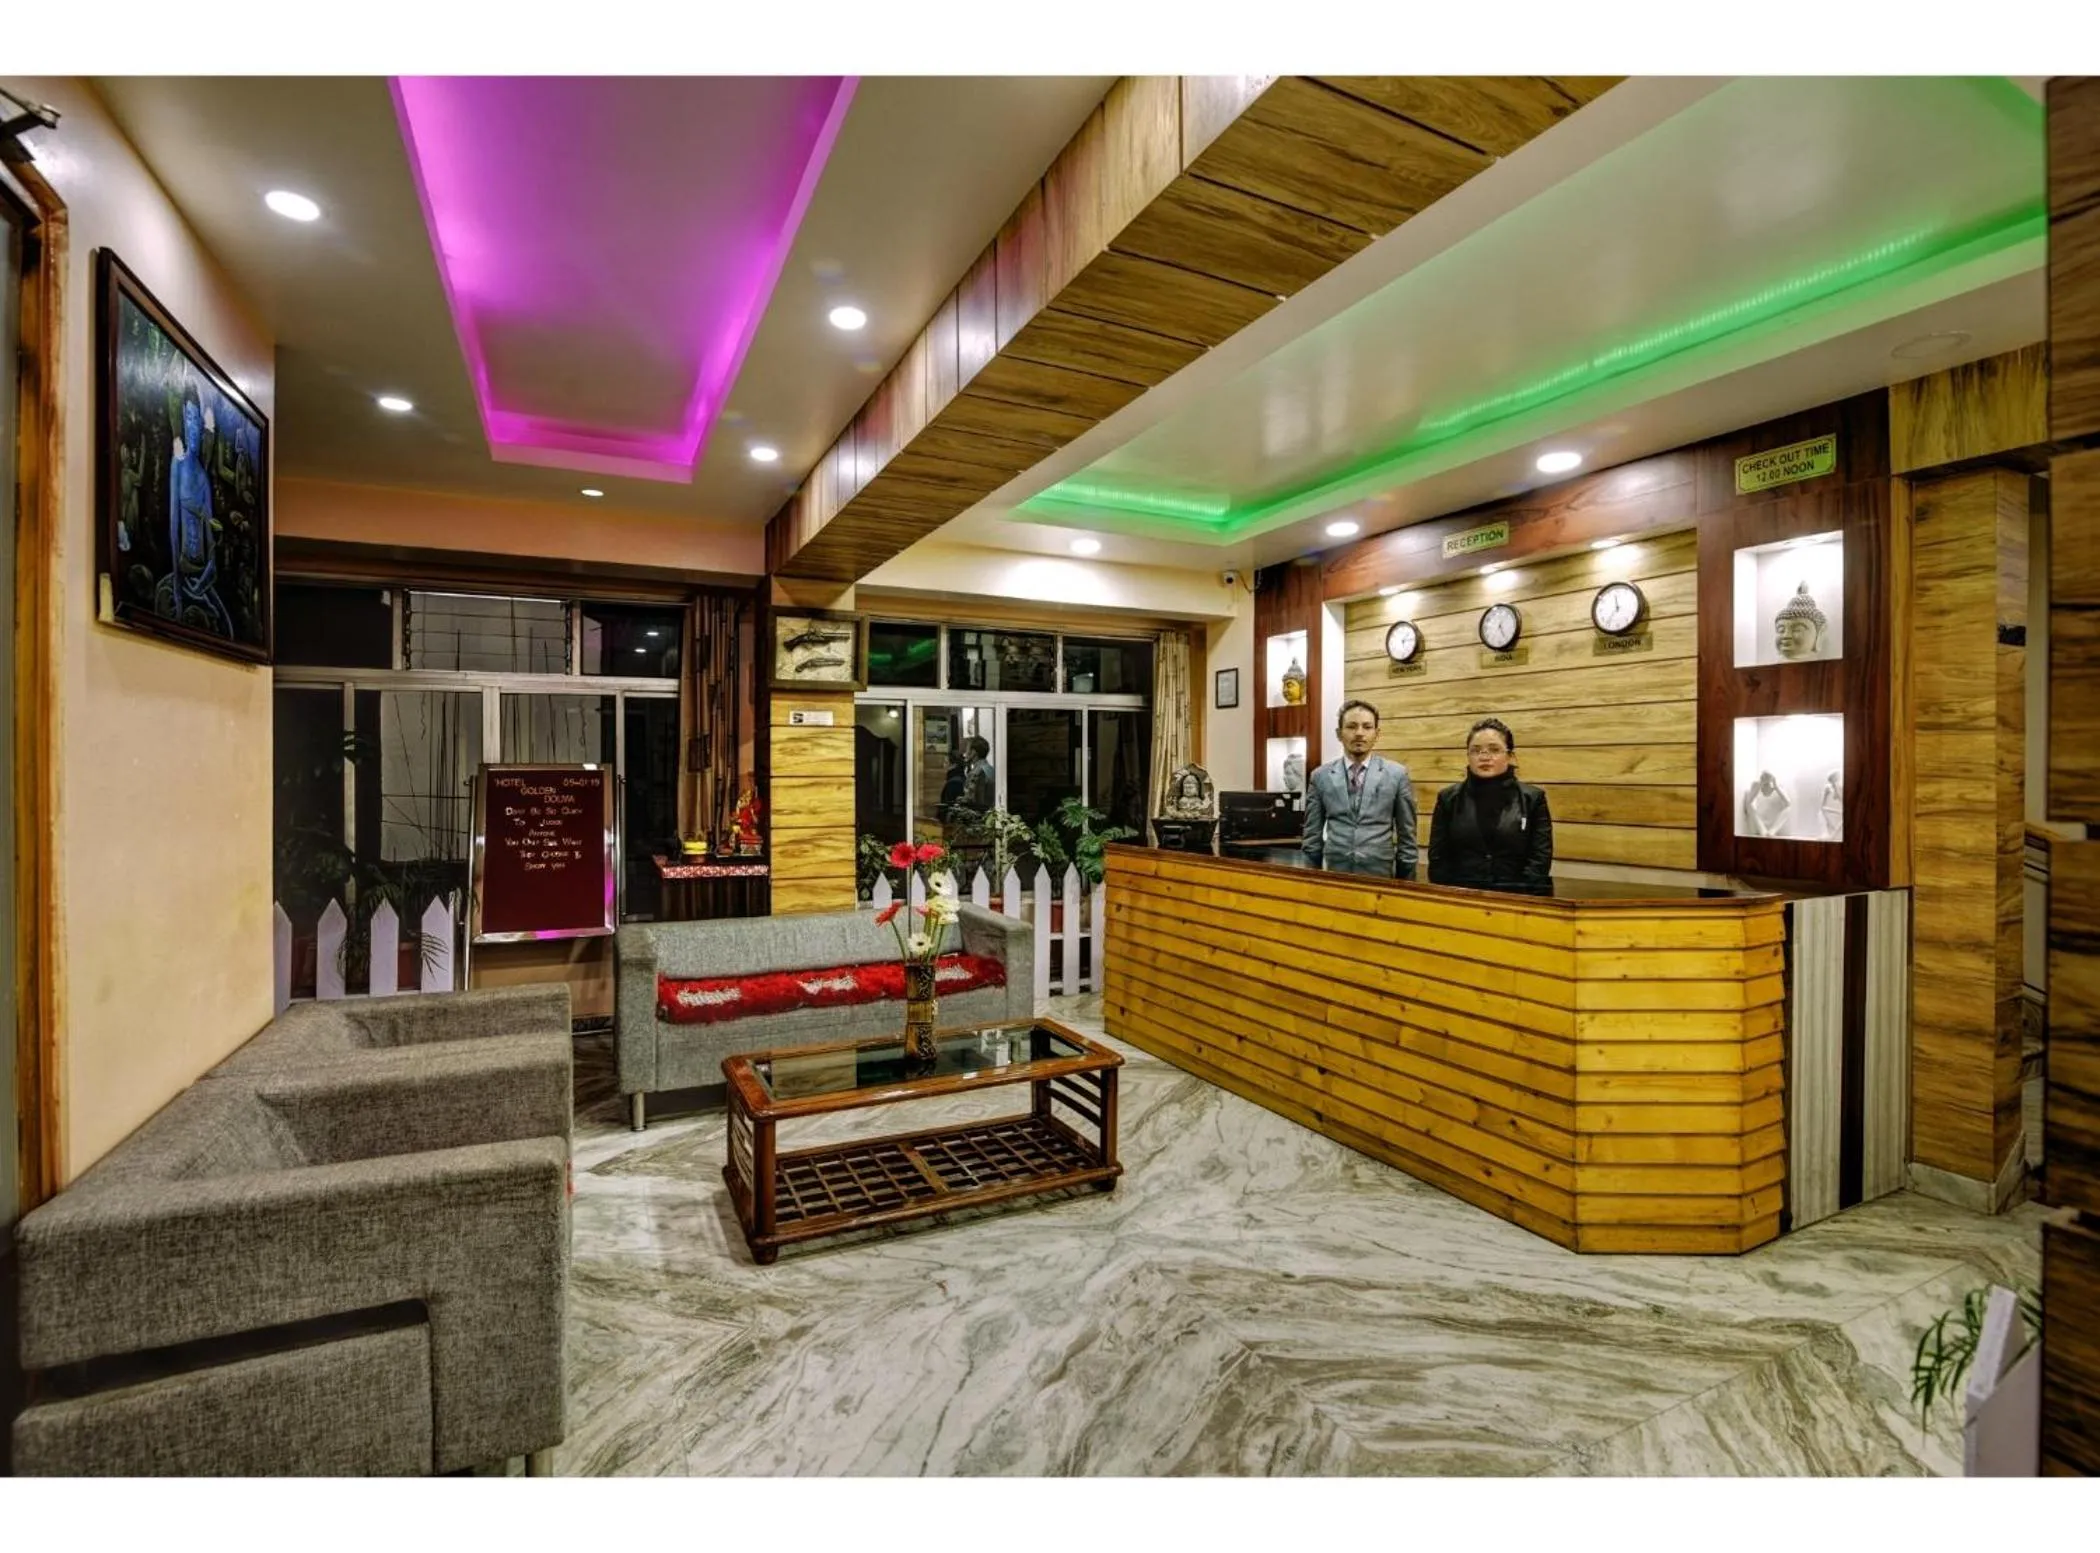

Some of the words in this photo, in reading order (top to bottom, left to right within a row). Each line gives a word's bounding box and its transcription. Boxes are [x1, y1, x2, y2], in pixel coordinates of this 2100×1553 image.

[1742, 456, 1777, 474] CHECK
[1779, 450, 1801, 464] OUT
[1804, 443, 1829, 457] TIME
[1783, 461, 1814, 477] NOON
[1447, 529, 1504, 551] RECEPTION
[1603, 640, 1641, 649] LONDON
[495, 778, 525, 787] HOTEL
[520, 786, 556, 796] GOLDEN
